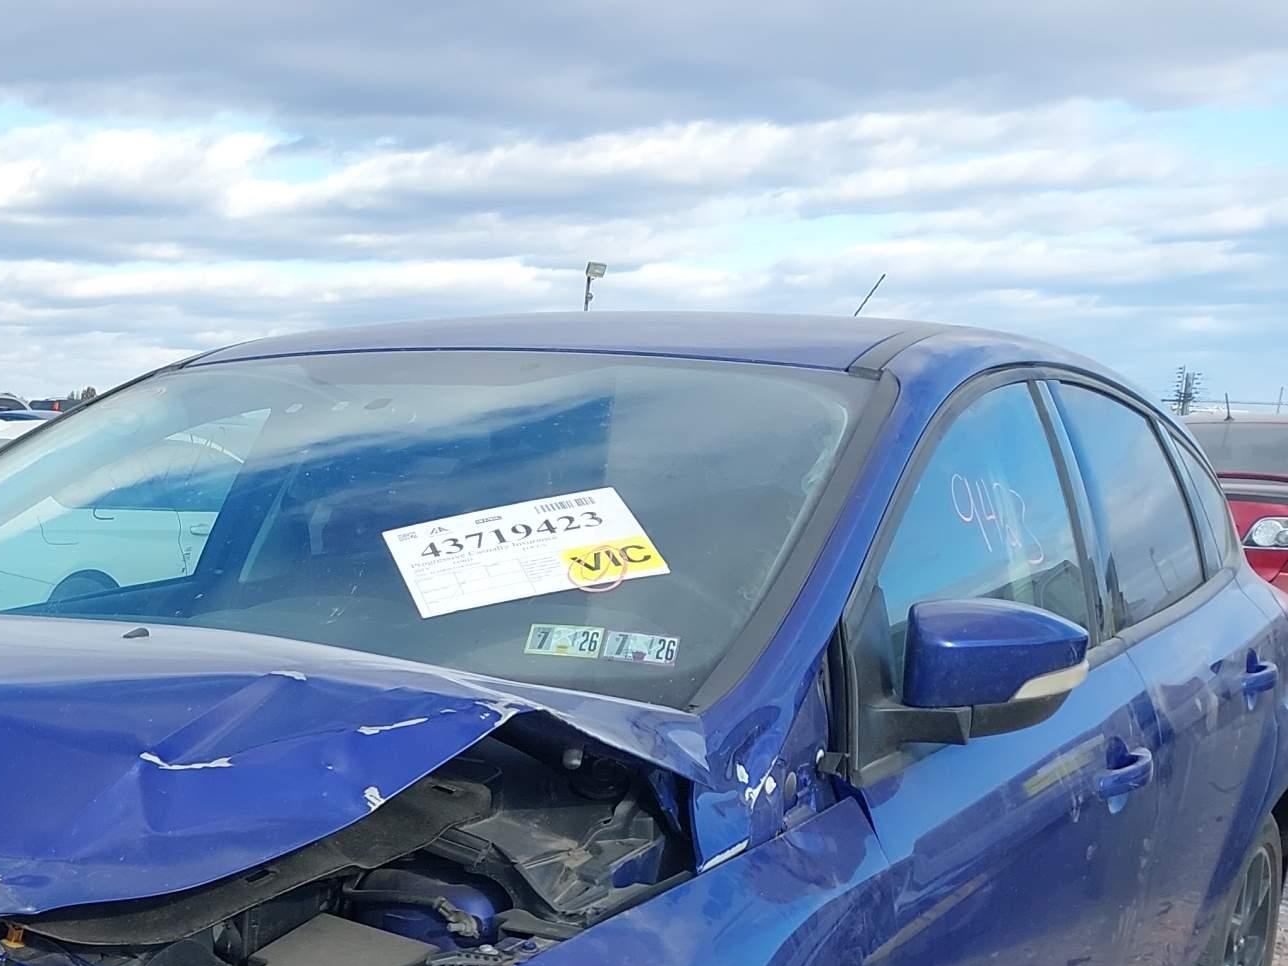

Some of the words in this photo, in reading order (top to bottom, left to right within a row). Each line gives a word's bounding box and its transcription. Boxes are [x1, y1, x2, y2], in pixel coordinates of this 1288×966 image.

[421, 511, 603, 557] 43719423
[570, 545, 652, 571] VIC
[537, 631, 550, 649] 7
[579, 631, 599, 652] 26
[615, 633, 629, 656] 7
[656, 639, 676, 661] 26
